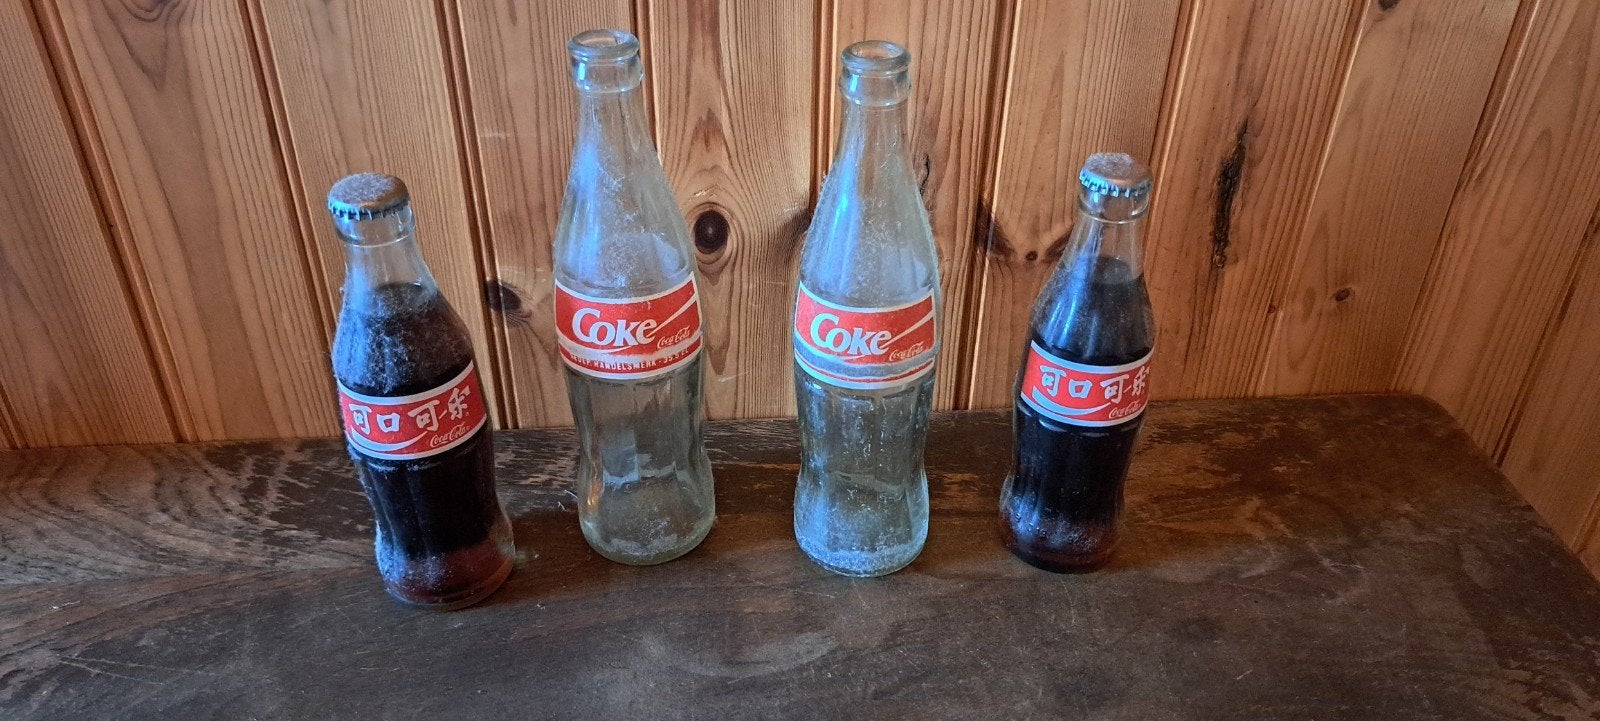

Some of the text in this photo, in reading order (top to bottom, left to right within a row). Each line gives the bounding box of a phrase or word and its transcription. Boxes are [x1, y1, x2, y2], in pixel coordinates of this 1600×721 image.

[572, 307, 658, 347] Coke
[810, 313, 892, 356] Coke
[348, 385, 471, 435] 可口可乐
